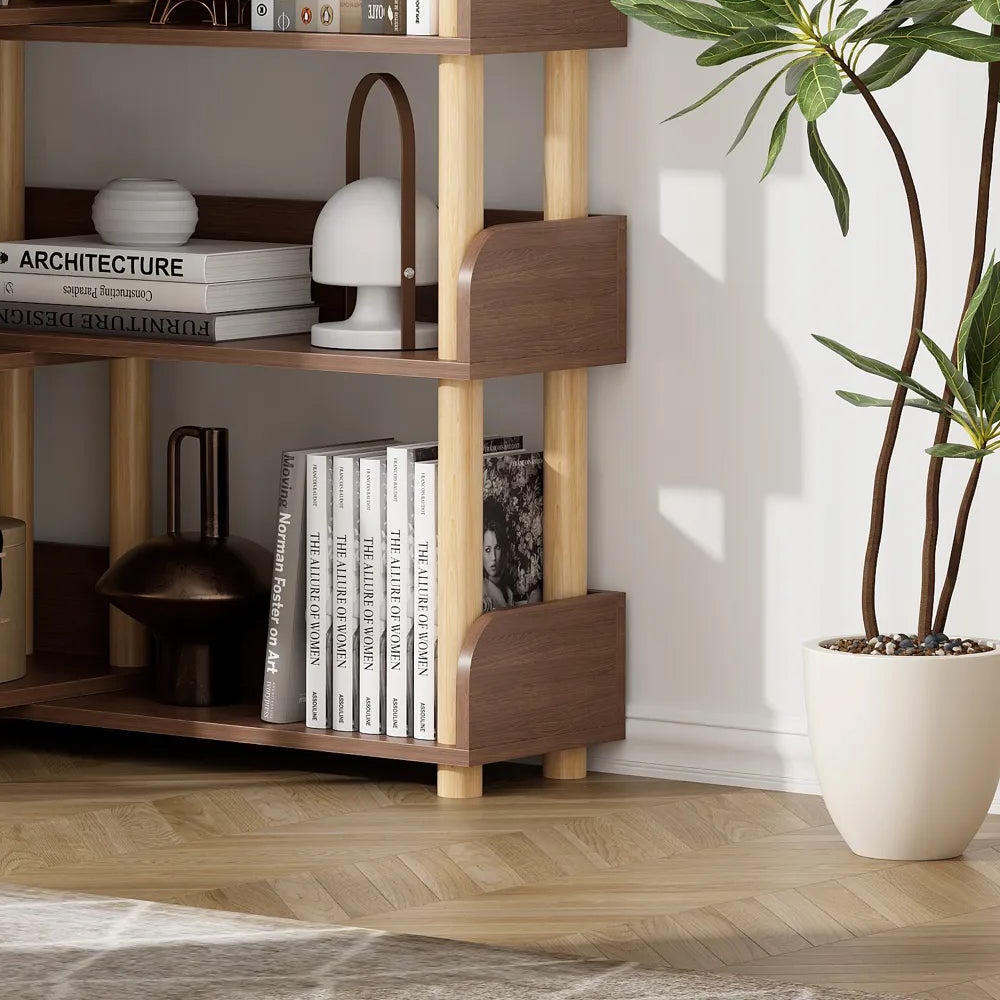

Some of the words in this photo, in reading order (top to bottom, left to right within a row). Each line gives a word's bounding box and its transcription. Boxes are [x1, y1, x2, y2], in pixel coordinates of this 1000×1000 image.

[19, 250, 184, 277] ARCHITECTURE
[63, 286, 98, 299] Paradies
[99, 285, 153, 301] Constructing
[81, 314, 210, 336] FURNITURE
[279, 454, 294, 509] Moving
[275, 512, 292, 573] Norman
[310, 532, 320, 555] THE
[337, 535, 346, 558] THE
[364, 537, 373, 560] THE
[391, 530, 400, 554] THE
[418, 542, 428, 565] THE
[310, 558, 320, 601] ALLURE
[337, 560, 346, 604] ALLURE
[364, 562, 373, 606] ALLURE
[391, 557, 400, 602] ALLURE
[418, 568, 428, 611] ALLURE
[271, 576, 286, 625] Foster
[310, 604, 320, 619] OF
[391, 605, 400, 621] OF
[337, 606, 346, 622] OF
[364, 609, 373, 624] OF
[418, 614, 428, 630] OF
[269, 627, 278, 646] on
[310, 622, 320, 666] WOMEN
[337, 624, 346, 668] WOMEN
[364, 627, 373, 671] WOMEN
[391, 624, 400, 670] WOMEN
[266, 649, 280, 675] Art
[418, 632, 428, 676] WOMEN
